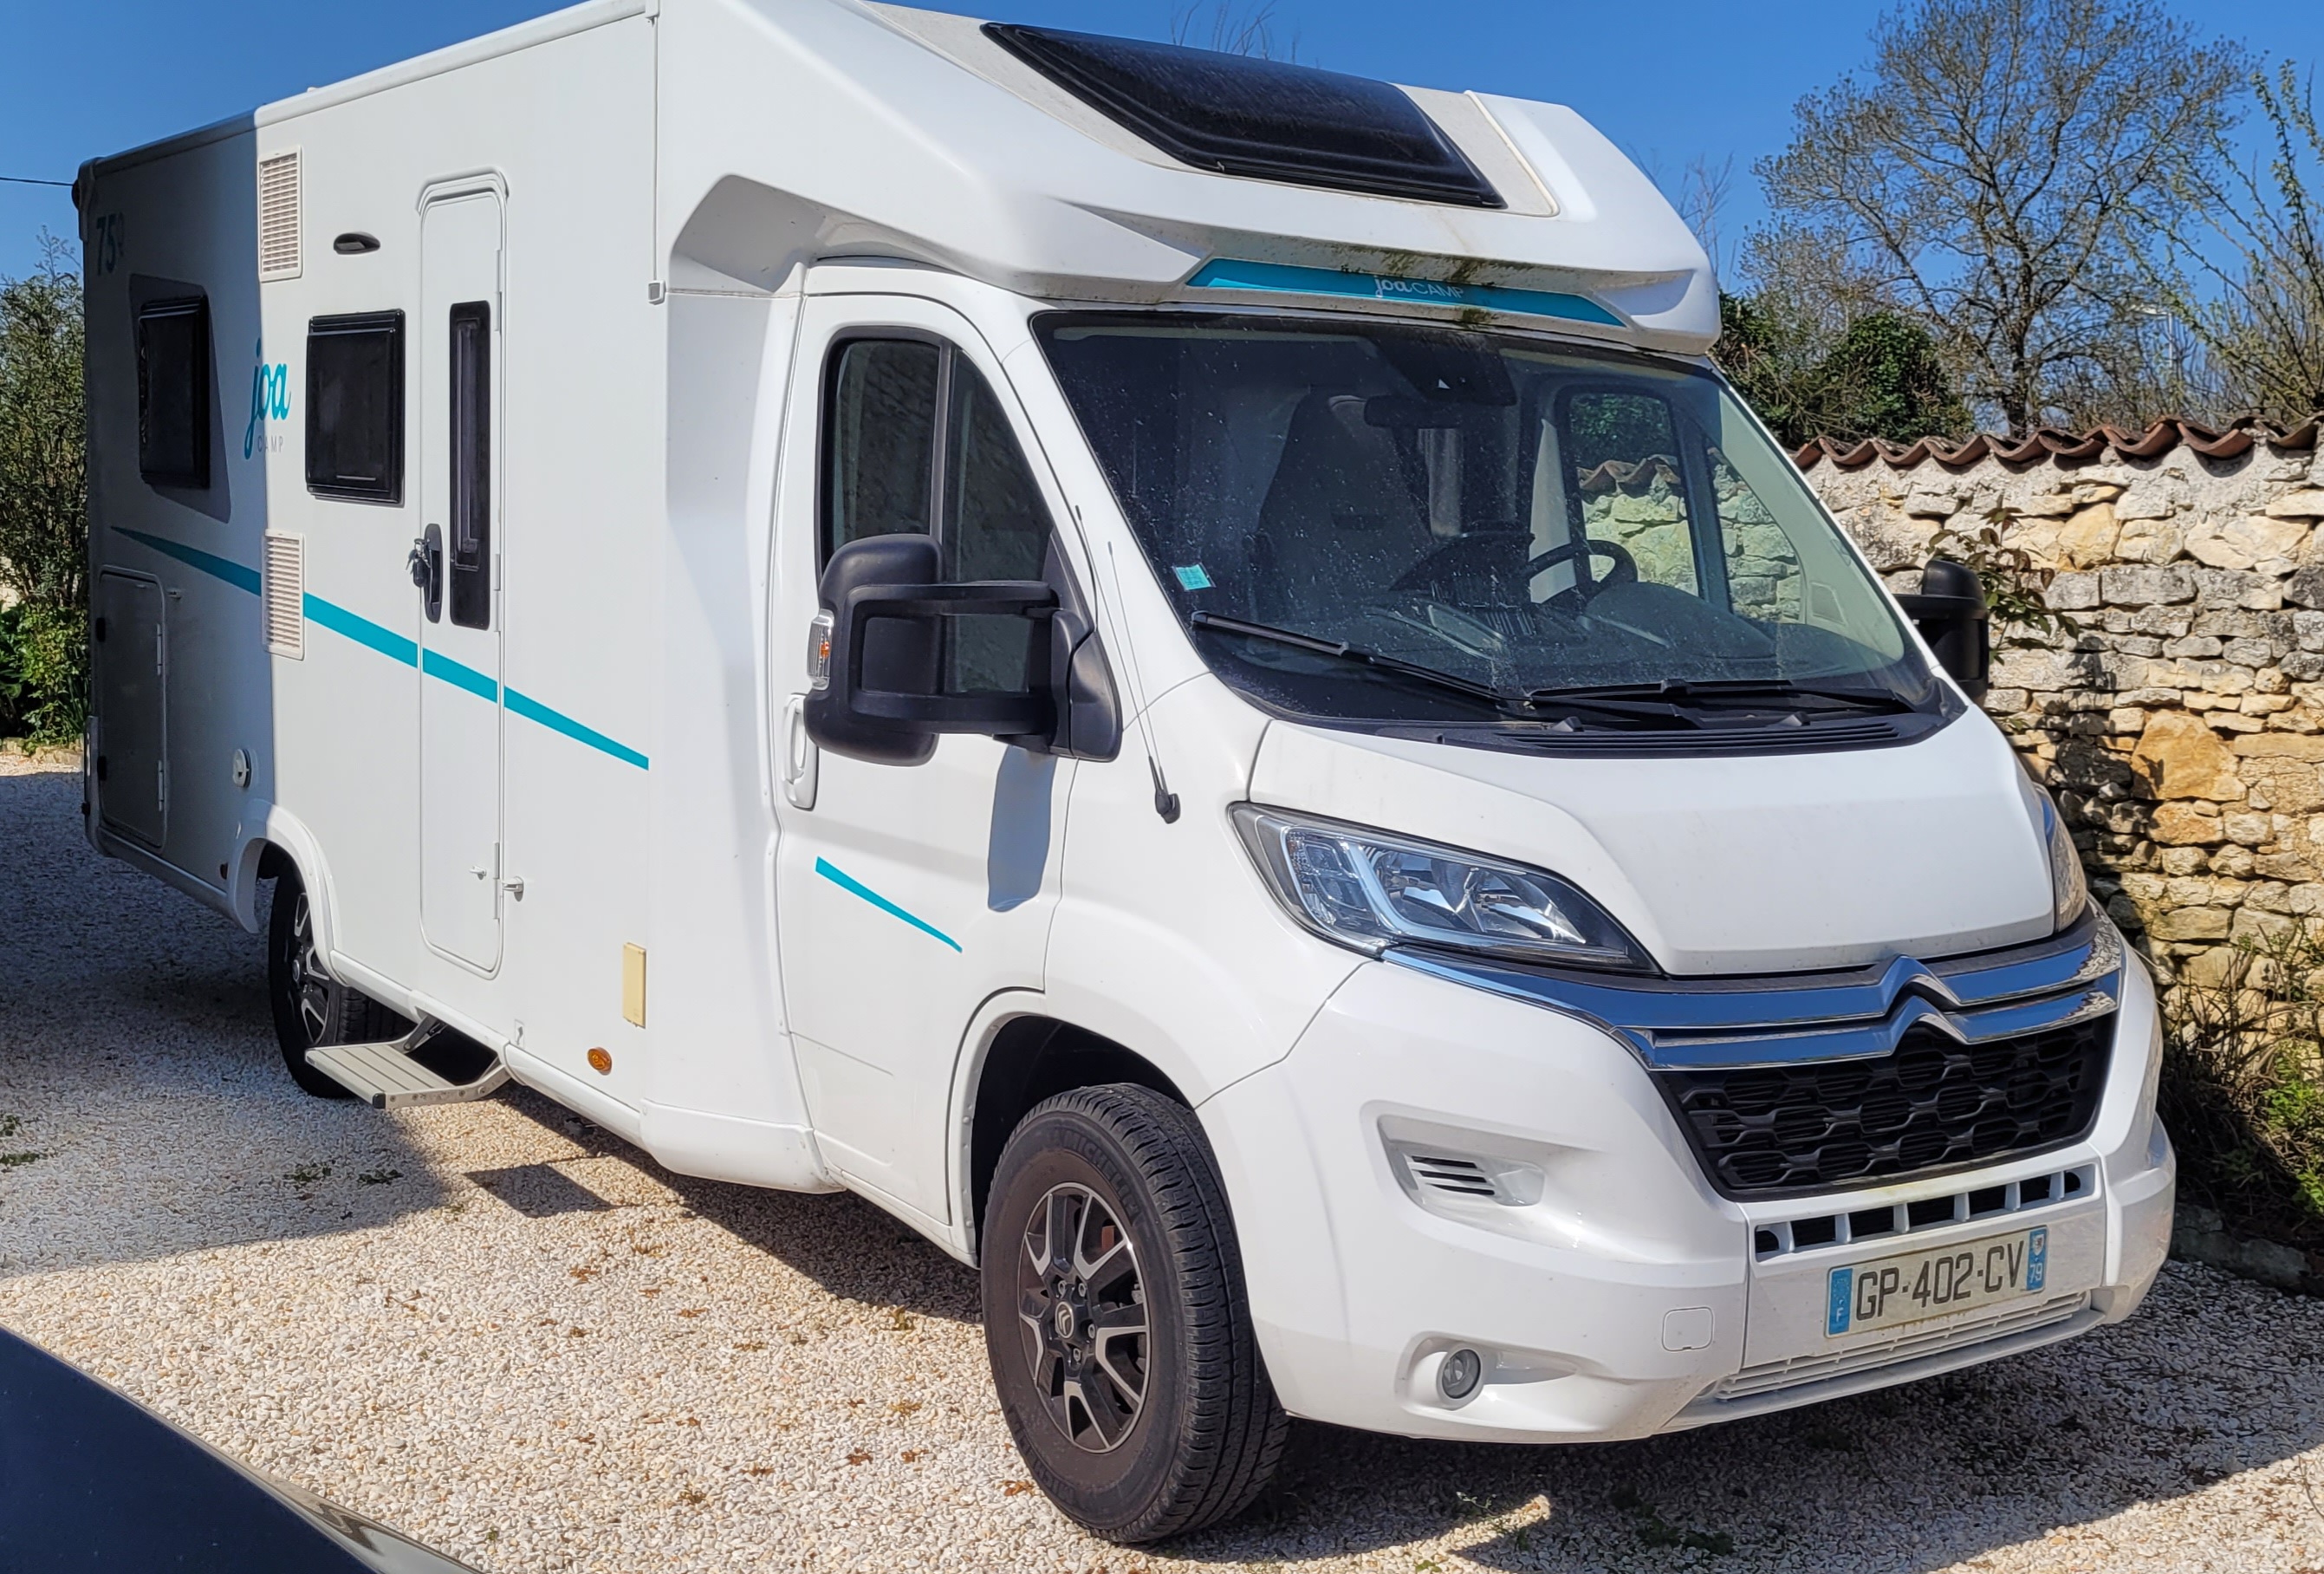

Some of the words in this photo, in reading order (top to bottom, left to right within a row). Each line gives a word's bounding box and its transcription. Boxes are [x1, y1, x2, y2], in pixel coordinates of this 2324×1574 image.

[243, 337, 292, 460] joa
[257, 435, 284, 453] CAMP
[1061, 1128, 1140, 1224] MICHELIN
[1855, 1240, 2025, 1321] GP-402-CV
[2029, 1263, 2043, 1284] 79
[1835, 1307, 1844, 1323] F
